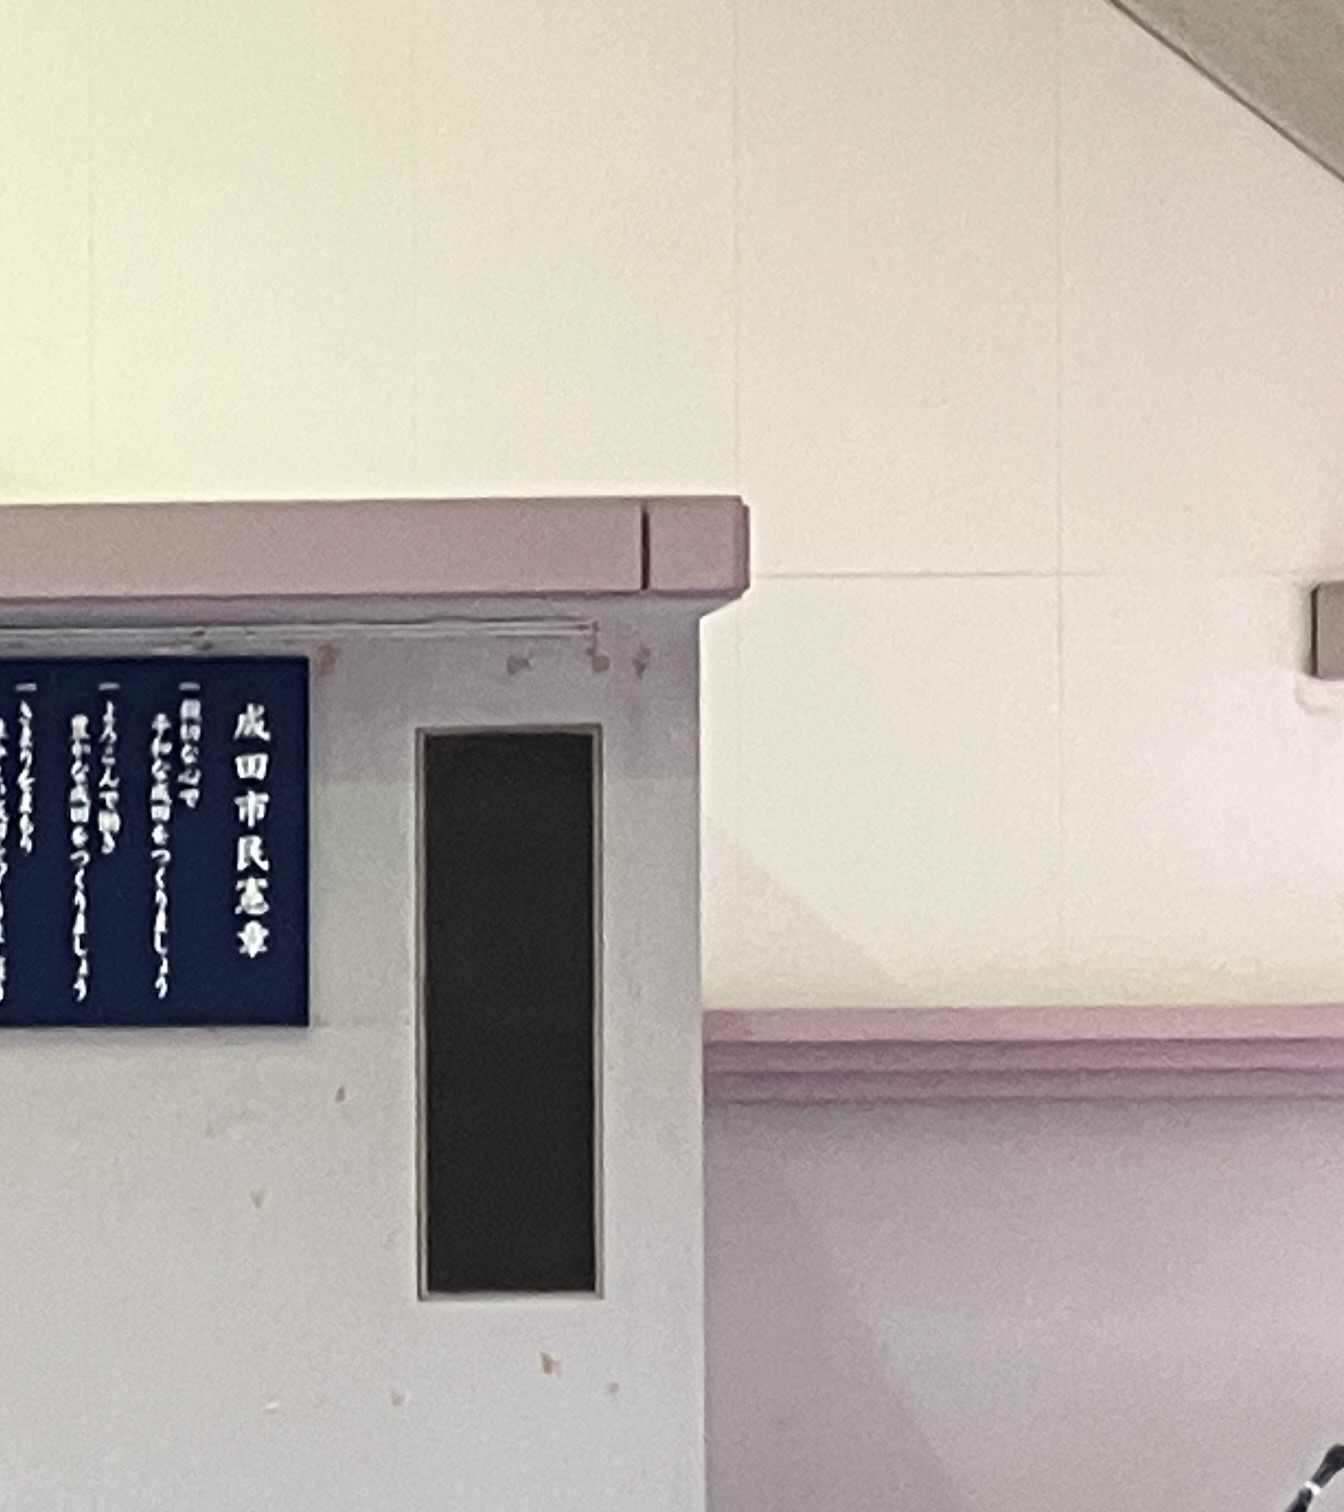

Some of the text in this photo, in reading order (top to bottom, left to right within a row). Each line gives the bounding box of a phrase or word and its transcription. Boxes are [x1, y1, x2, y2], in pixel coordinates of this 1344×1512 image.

[233, 702, 271, 959] 成田市民憲章
